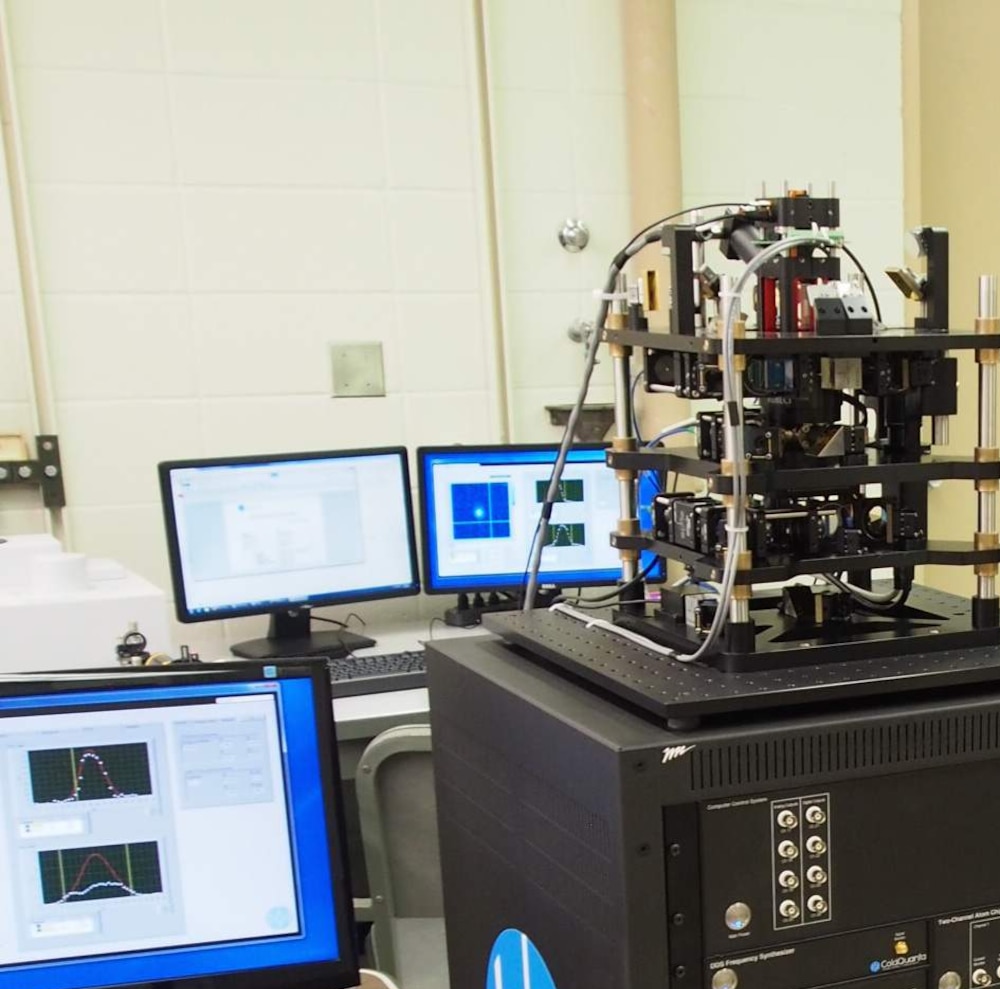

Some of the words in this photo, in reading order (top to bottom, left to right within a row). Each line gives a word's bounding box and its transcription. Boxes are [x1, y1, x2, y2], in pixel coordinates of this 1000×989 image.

[725, 954, 758, 967] Frequency
[758, 948, 796, 961] Synthesizer
[880, 953, 927, 970] ColdQuanta
